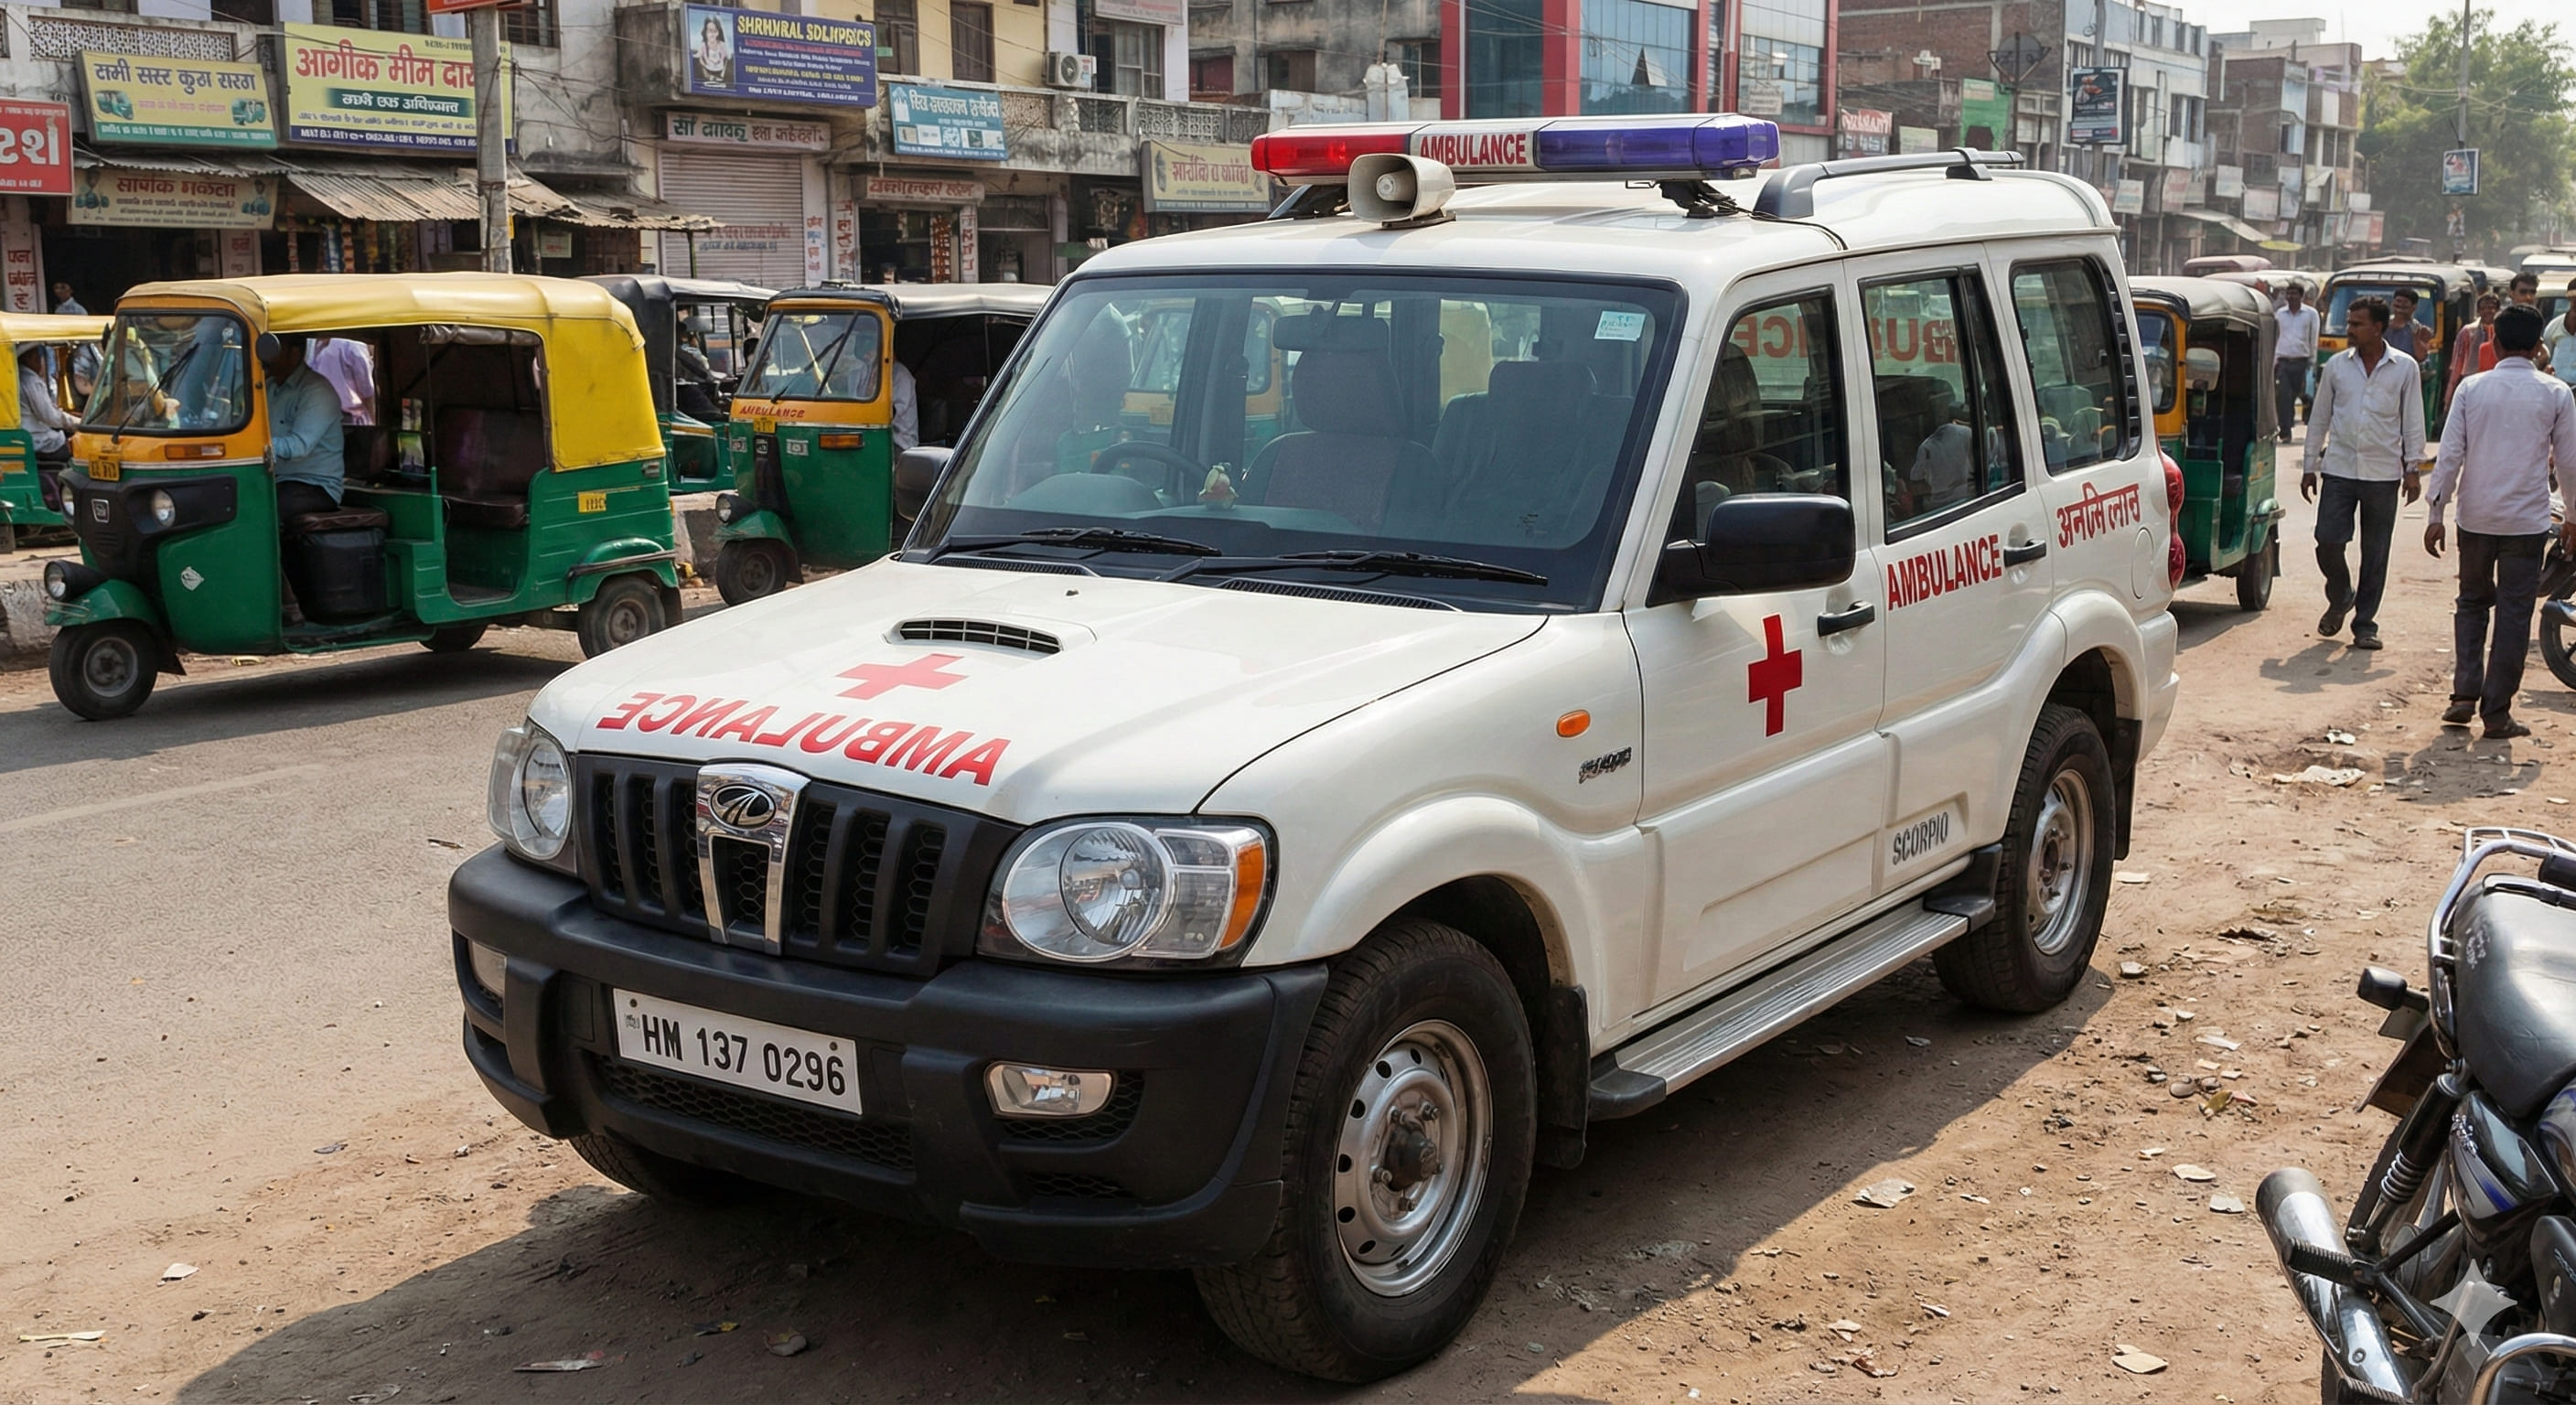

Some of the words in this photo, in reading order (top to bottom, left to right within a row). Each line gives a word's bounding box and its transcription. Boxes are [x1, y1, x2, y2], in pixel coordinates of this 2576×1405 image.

[1420, 134, 1527, 165] AMBULANCE
[1886, 534, 2002, 611] AMBULANCE
[1893, 811, 1948, 865] SCORPIO
[642, 1014, 682, 1061] HM
[696, 1027, 747, 1073] 137
[763, 1043, 845, 1096] 0296
